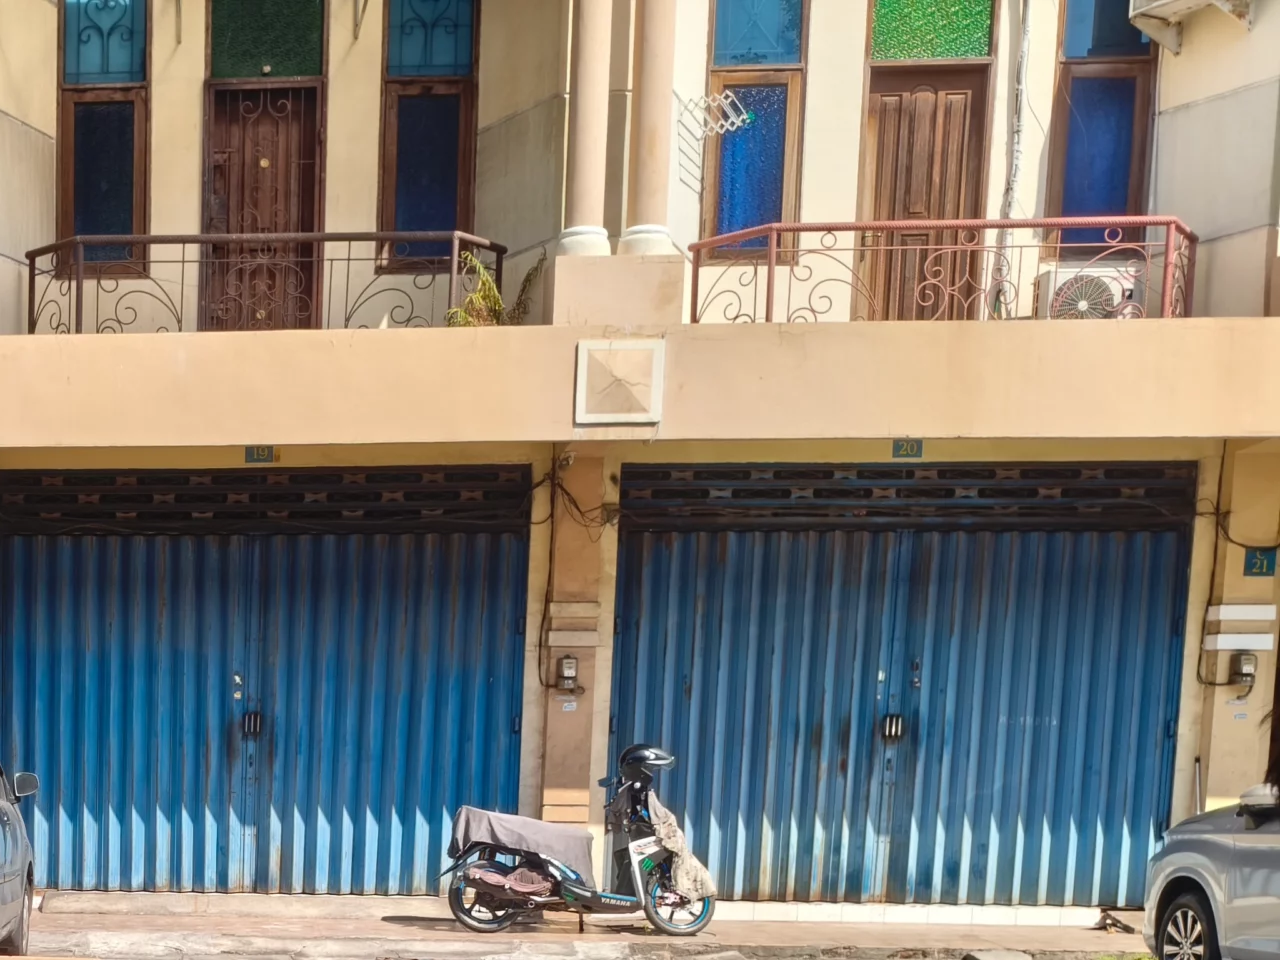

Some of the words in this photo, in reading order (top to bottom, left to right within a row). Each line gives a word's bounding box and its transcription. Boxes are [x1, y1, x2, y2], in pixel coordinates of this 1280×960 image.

[253, 447, 269, 459] 19
[898, 441, 918, 455] 20
[1251, 559, 1268, 573] 21
[601, 897, 631, 908] YAMAHA
